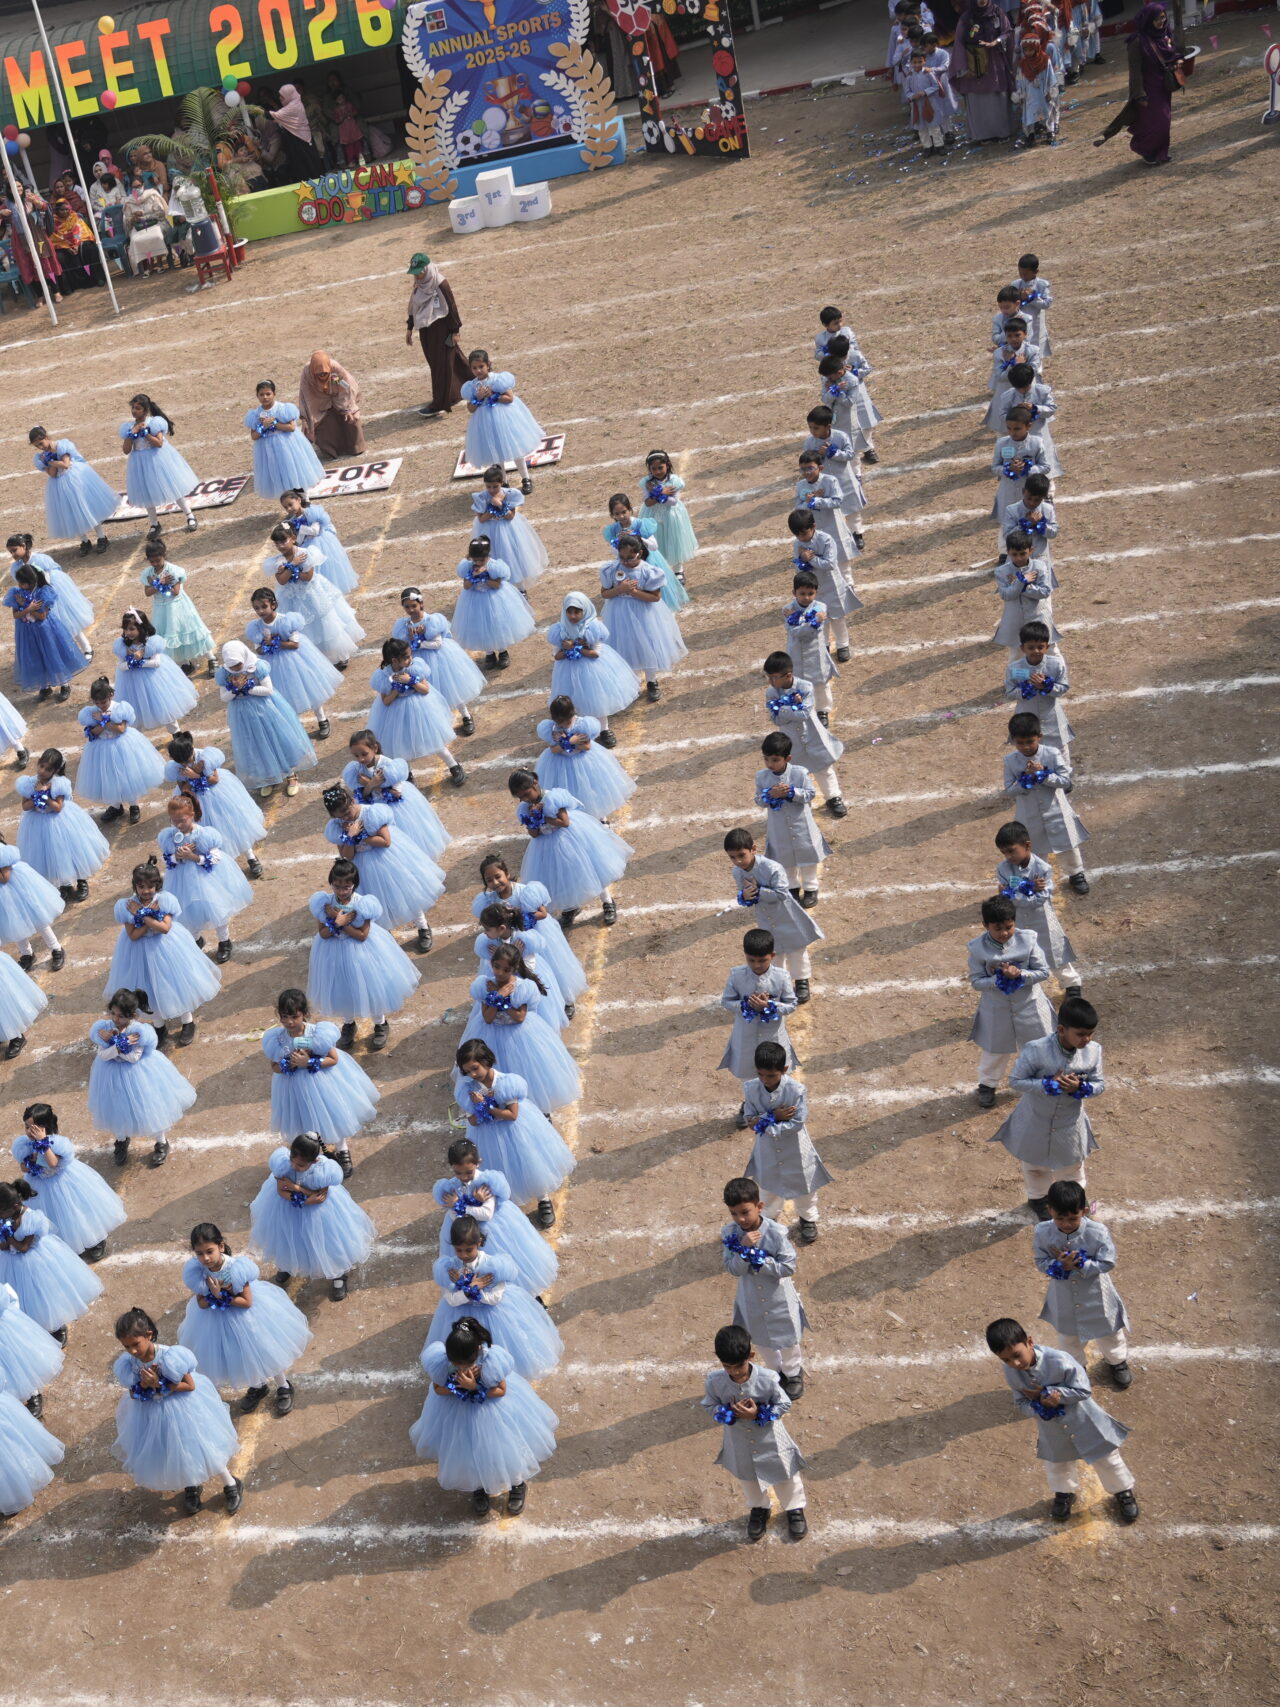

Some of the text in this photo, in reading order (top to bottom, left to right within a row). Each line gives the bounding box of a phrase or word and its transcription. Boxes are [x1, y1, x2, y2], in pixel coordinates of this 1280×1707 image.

[428, 11, 563, 58] ANNUAL SPORTS
[4, 17, 174, 129] MEET
[209, 0, 393, 80] 2026
[465, 39, 531, 69] 2025-26
[718, 135, 740, 152] ON
[307, 162, 397, 198] YOU CAN
[314, 195, 345, 225] DO
[484, 189, 502, 205] 1st
[519, 196, 539, 213] 2nd
[456, 208, 476, 226] 3rd
